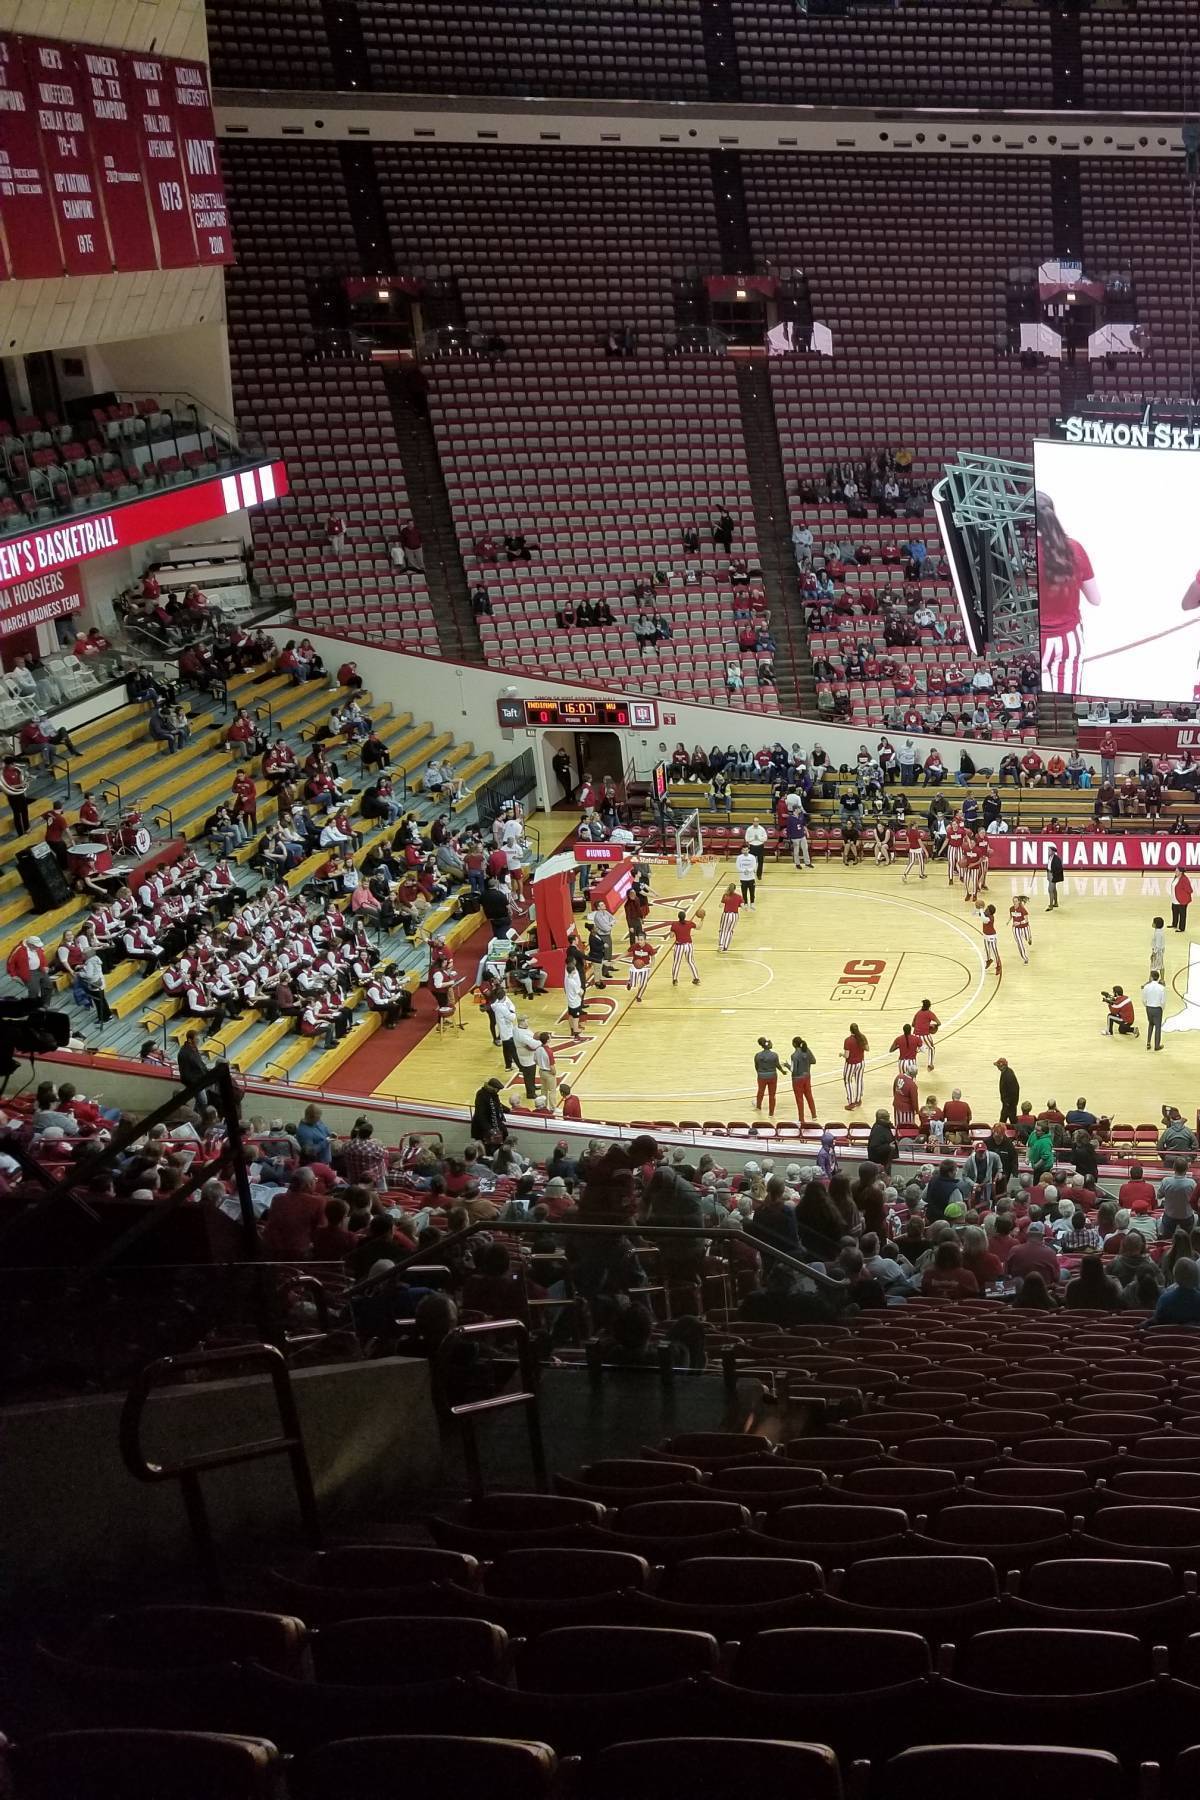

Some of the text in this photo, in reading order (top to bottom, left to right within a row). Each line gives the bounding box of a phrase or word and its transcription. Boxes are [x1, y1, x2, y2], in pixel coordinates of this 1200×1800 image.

[1066, 416, 1149, 447] SIMON
[35, 516, 118, 567] BASKETBALL
[12, 571, 65, 605] HOOSIERS
[0, 614, 28, 634] MARCH
[28, 600, 61, 624] MADNESS
[61, 594, 80, 612] TEAM
[501, 708, 518, 718] Taft
[540, 711, 548, 722] 0
[565, 703, 593, 713] 16:07
[618, 712, 626, 723] 0
[1177, 730, 1194, 745] IU
[1010, 841, 1127, 865] INDIANA
